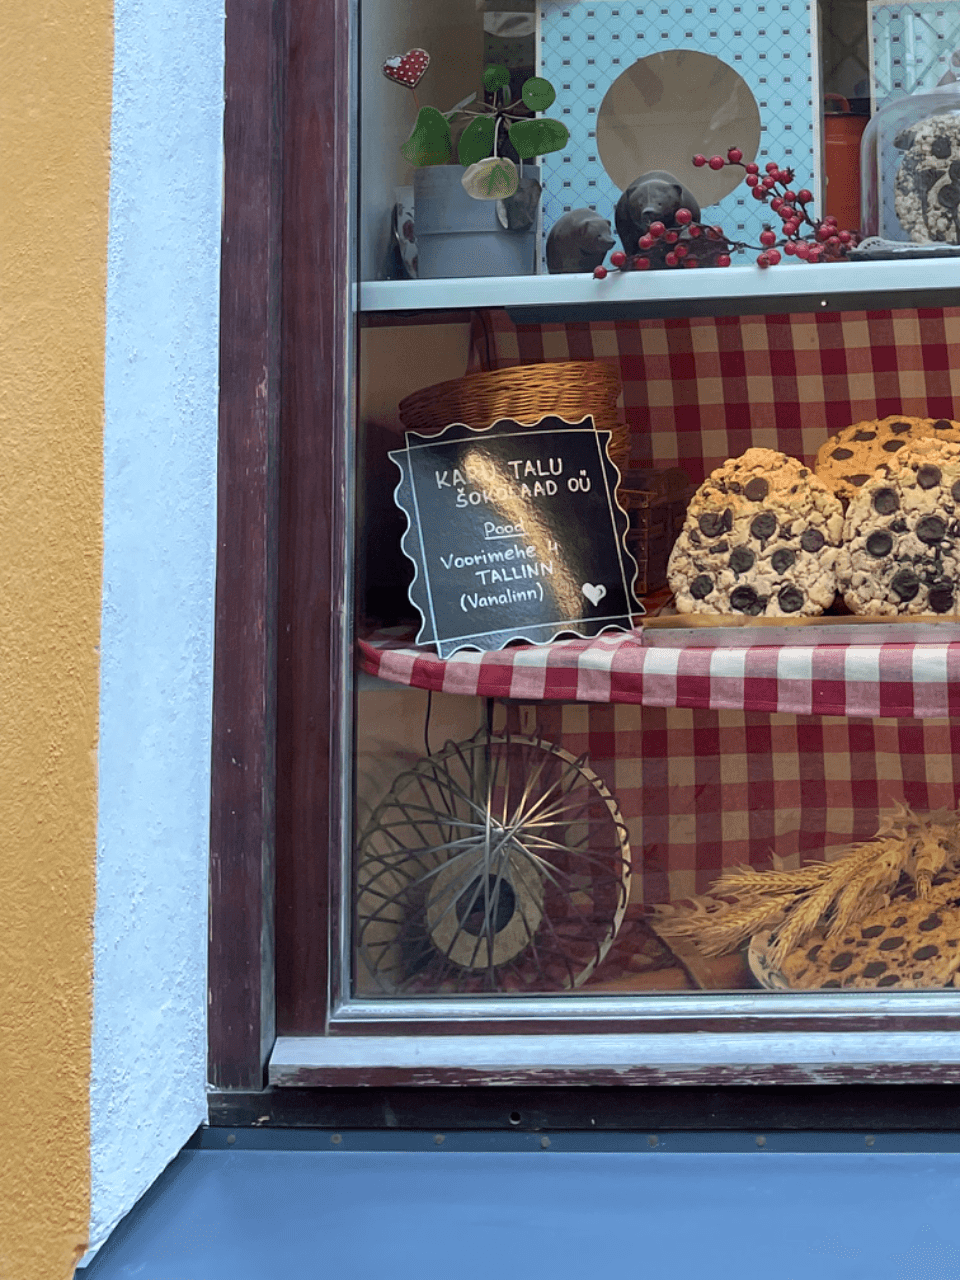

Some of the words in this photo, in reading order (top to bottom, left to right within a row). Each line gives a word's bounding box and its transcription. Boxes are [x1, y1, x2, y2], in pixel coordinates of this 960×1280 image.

[507, 458, 563, 480] TALU
[567, 469, 591, 492] OÜ
[483, 516, 526, 537] Pood
[440, 544, 537, 570] Voorimehe
[475, 560, 553, 585] TALLINN
[460, 582, 544, 612] (Vanalinn)
